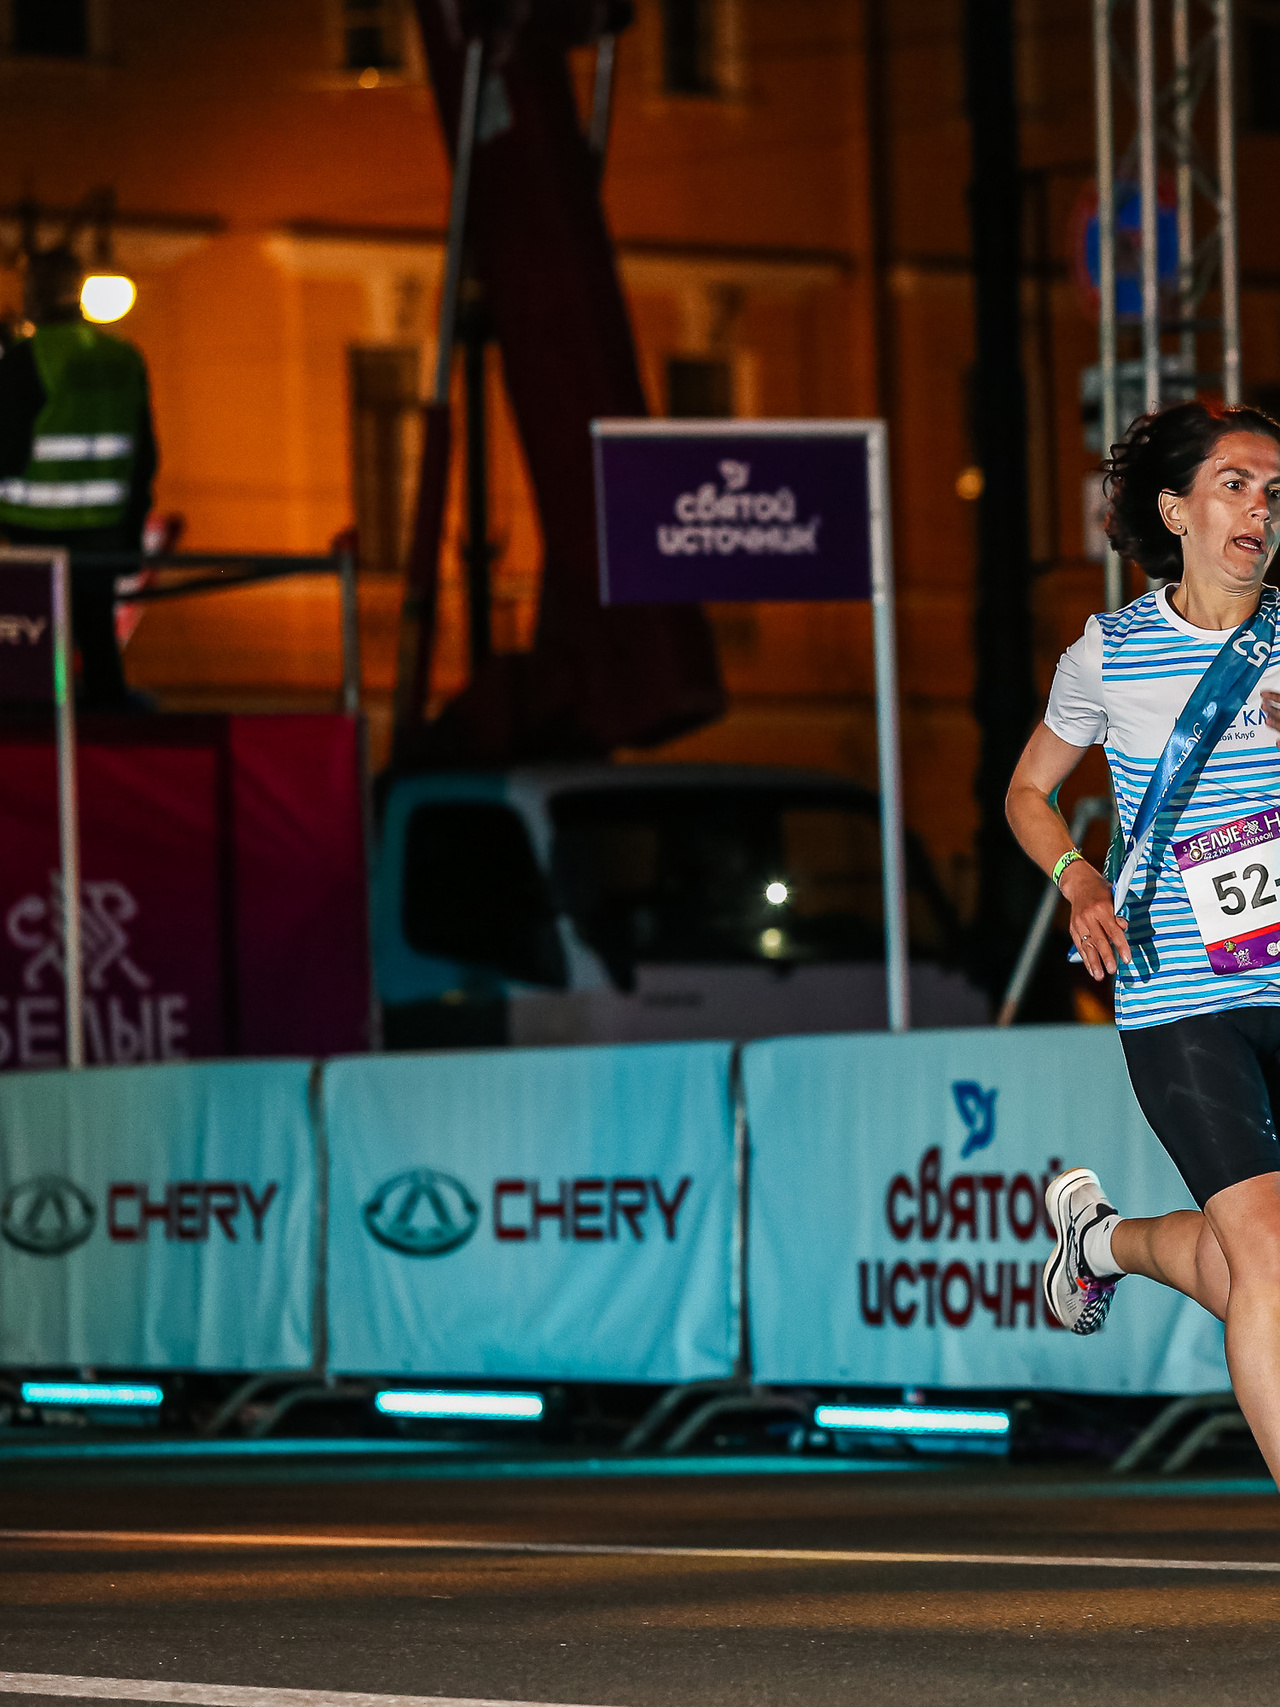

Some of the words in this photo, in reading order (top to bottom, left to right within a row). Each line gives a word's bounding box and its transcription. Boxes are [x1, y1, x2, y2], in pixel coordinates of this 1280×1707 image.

[1232, 629, 1272, 667] 52
[1234, 730, 1256, 741] Клуб
[1189, 824, 1242, 855] БЕЛЫЕ
[107, 1182, 279, 1242] CHERY
[492, 1175, 693, 1243] CHERY
